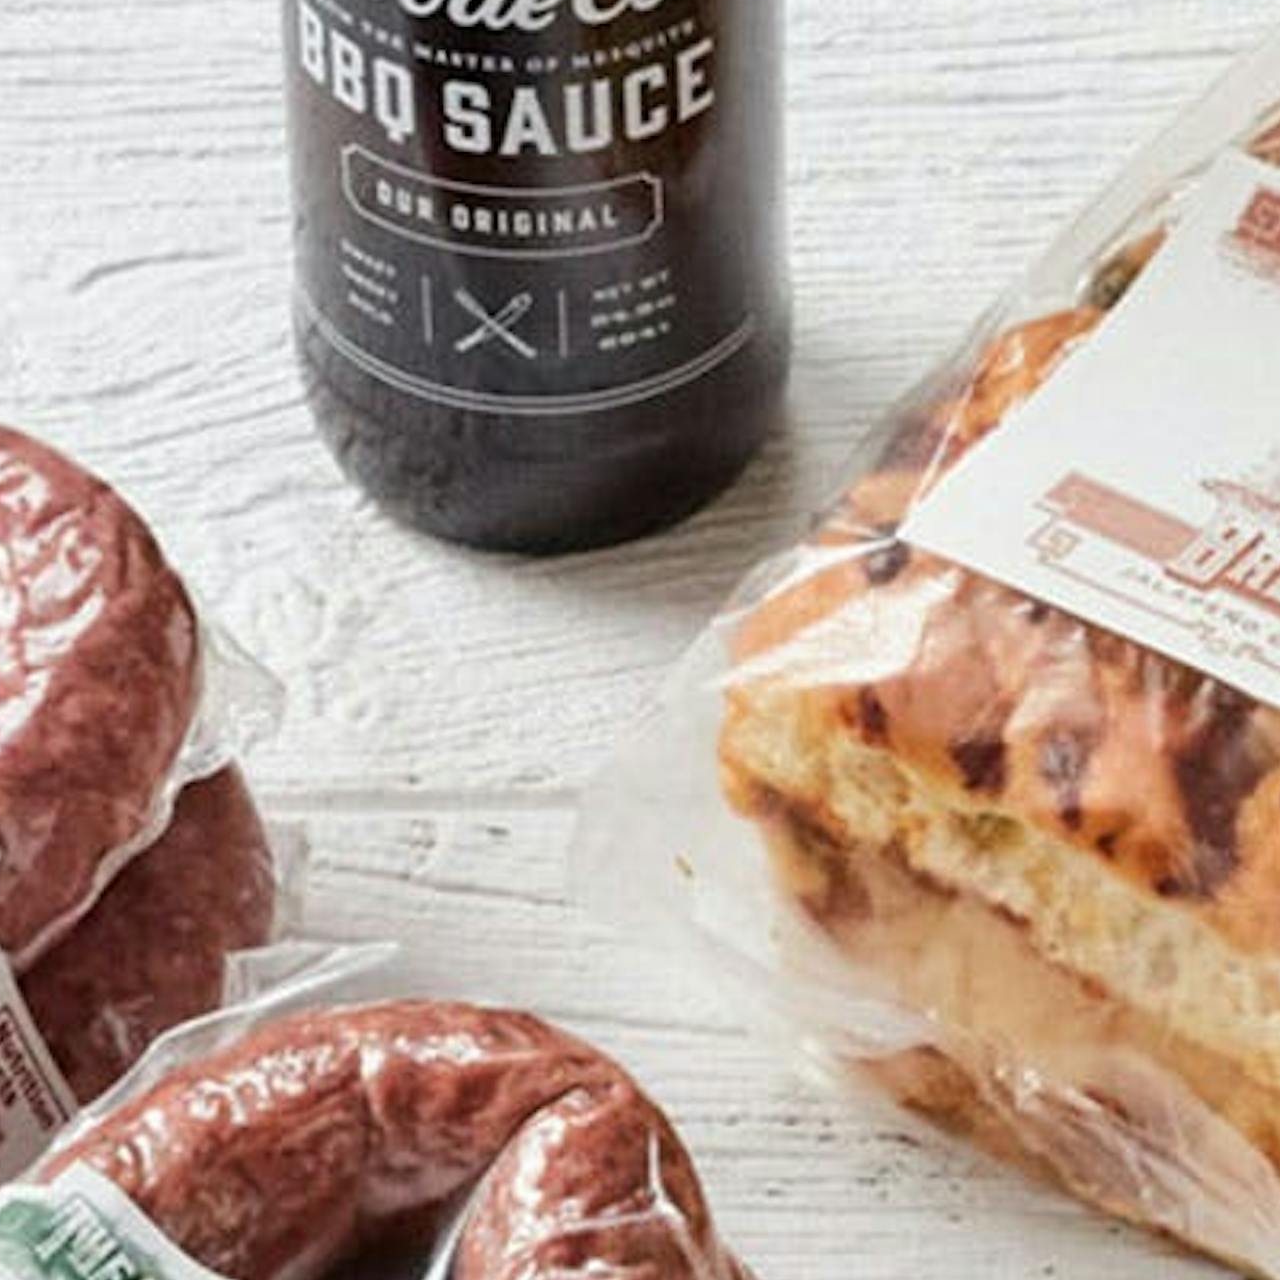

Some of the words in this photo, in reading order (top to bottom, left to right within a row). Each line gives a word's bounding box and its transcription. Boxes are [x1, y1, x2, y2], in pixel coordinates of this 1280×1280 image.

[442, 37, 716, 157] SAUCE
[376, 177, 434, 219] OUR
[450, 203, 618, 237] ORIGINAL
